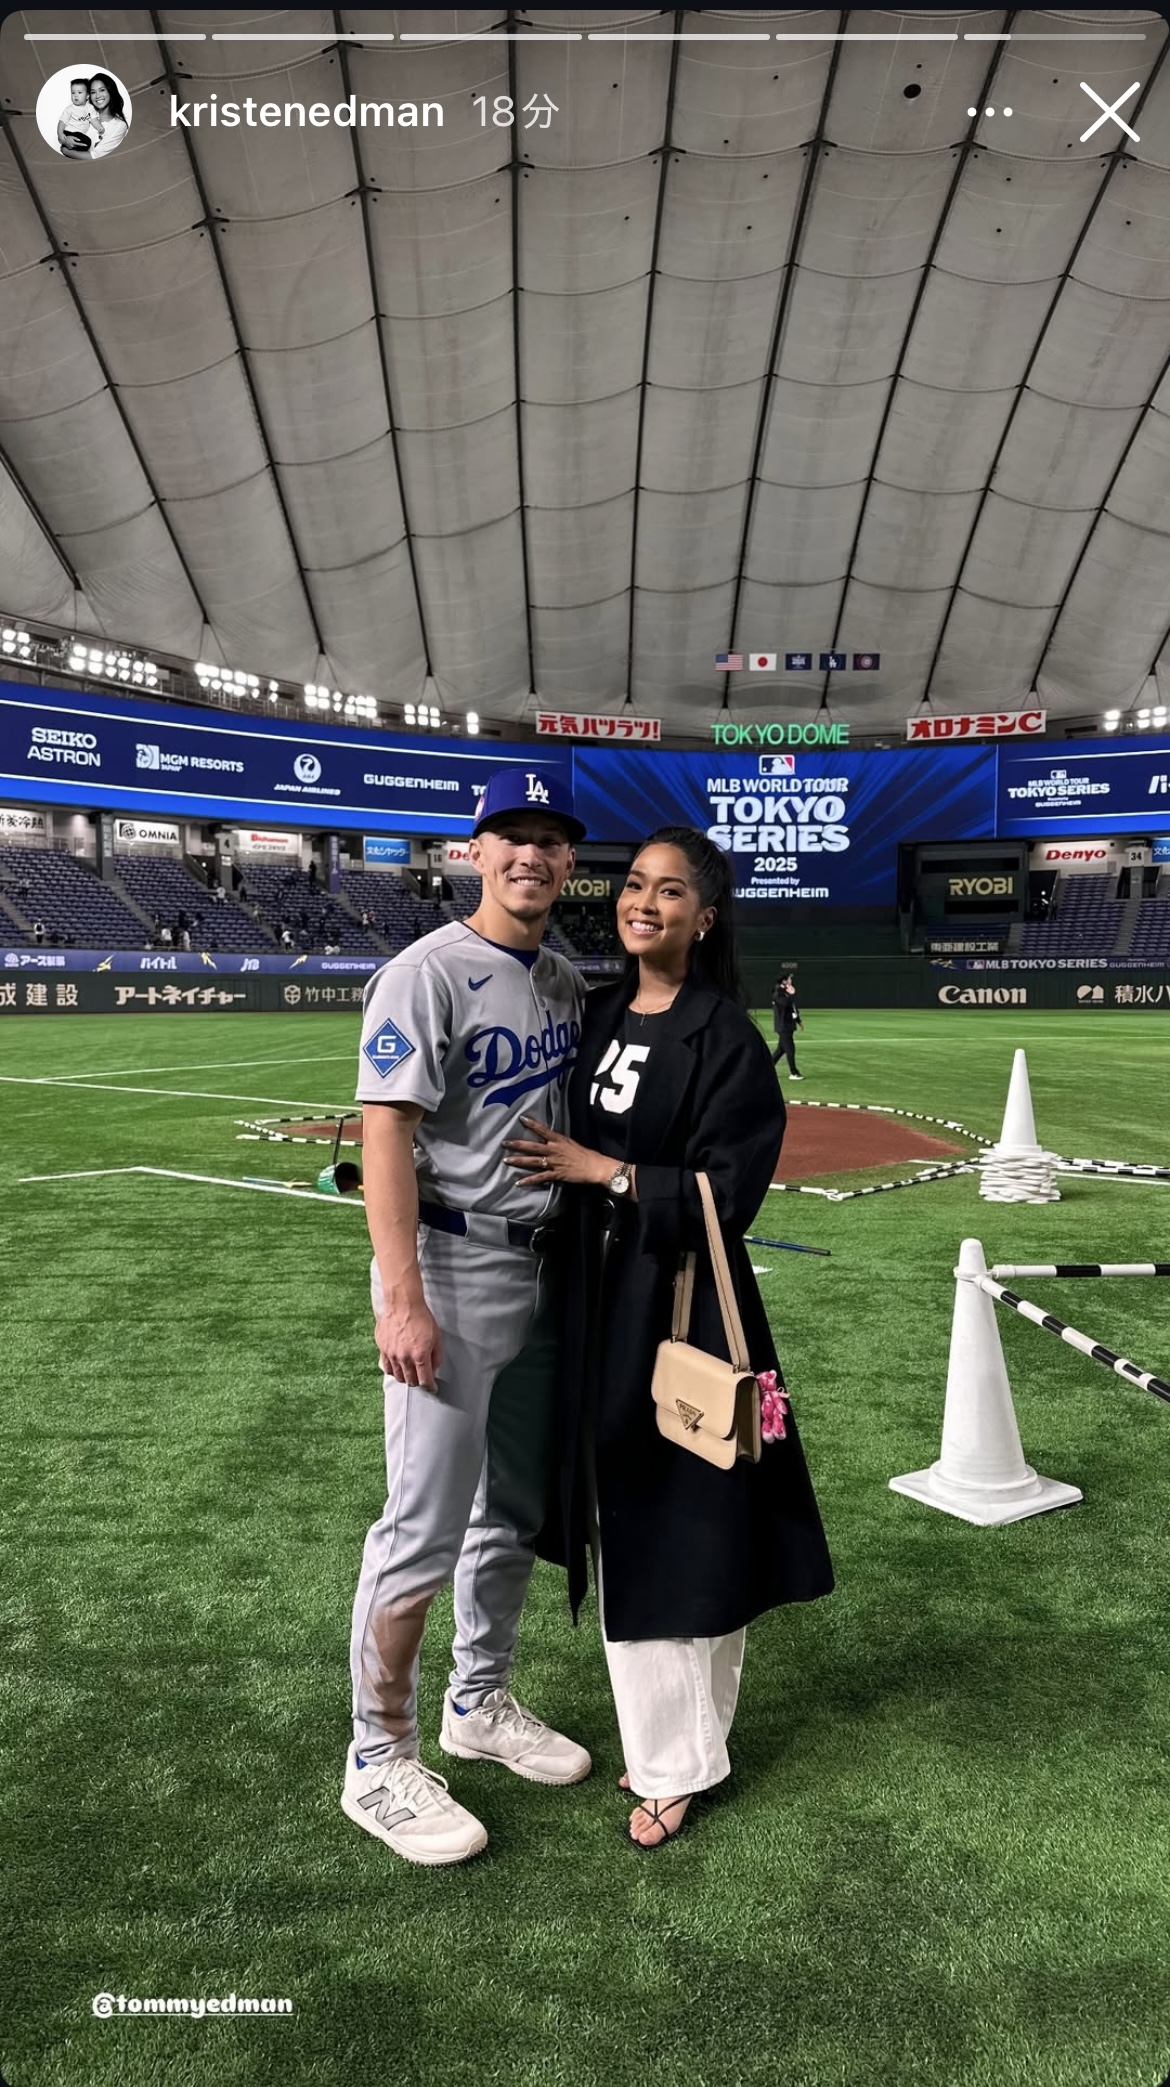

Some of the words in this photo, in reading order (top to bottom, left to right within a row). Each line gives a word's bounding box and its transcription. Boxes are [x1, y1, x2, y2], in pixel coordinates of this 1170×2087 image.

[911, 711, 1042, 739] オロナミンC
[31, 727, 97, 749] SEIKO
[710, 723, 785, 746] TOKYO
[787, 723, 850, 746] DOME
[27, 745, 101, 767] ASTRON
[160, 753, 188, 766] MGM
[190, 756, 244, 773] RESORTS
[363, 773, 460, 791] GUGGENHEIM
[525, 773, 550, 804] LA
[707, 778, 741, 793] MLB
[742, 778, 802, 793] WORLD
[802, 777, 849, 793] TOUR
[1008, 787, 1057, 798] TOKYO
[1057, 783, 1110, 796] SERIES
[1043, 779, 1069, 787] WORLD
[1069, 777, 1089, 785] TOUR
[709, 795, 846, 824] TOKYO
[139, 829, 177, 841] OMNIA
[706, 824, 850, 852] SERIES
[1045, 849, 1107, 861] Denyo
[1131, 852, 1142, 861] 34
[754, 857, 798, 872] 2025
[751, 877, 790, 885] Presented
[790, 877, 800, 886] by
[949, 876, 1013, 896] RYOBI
[731, 887, 830, 898] UGGENHEIM
[985, 960, 1010, 970] MLB
[1010, 959, 1057, 970] TOKYO
[1057, 958, 1108, 969] SERIES
[114, 985, 247, 1006] アートネイチャー
[937, 985, 1027, 1004] Canon
[377, 1035, 398, 1053] G
[465, 1011, 580, 1090] Dodge
